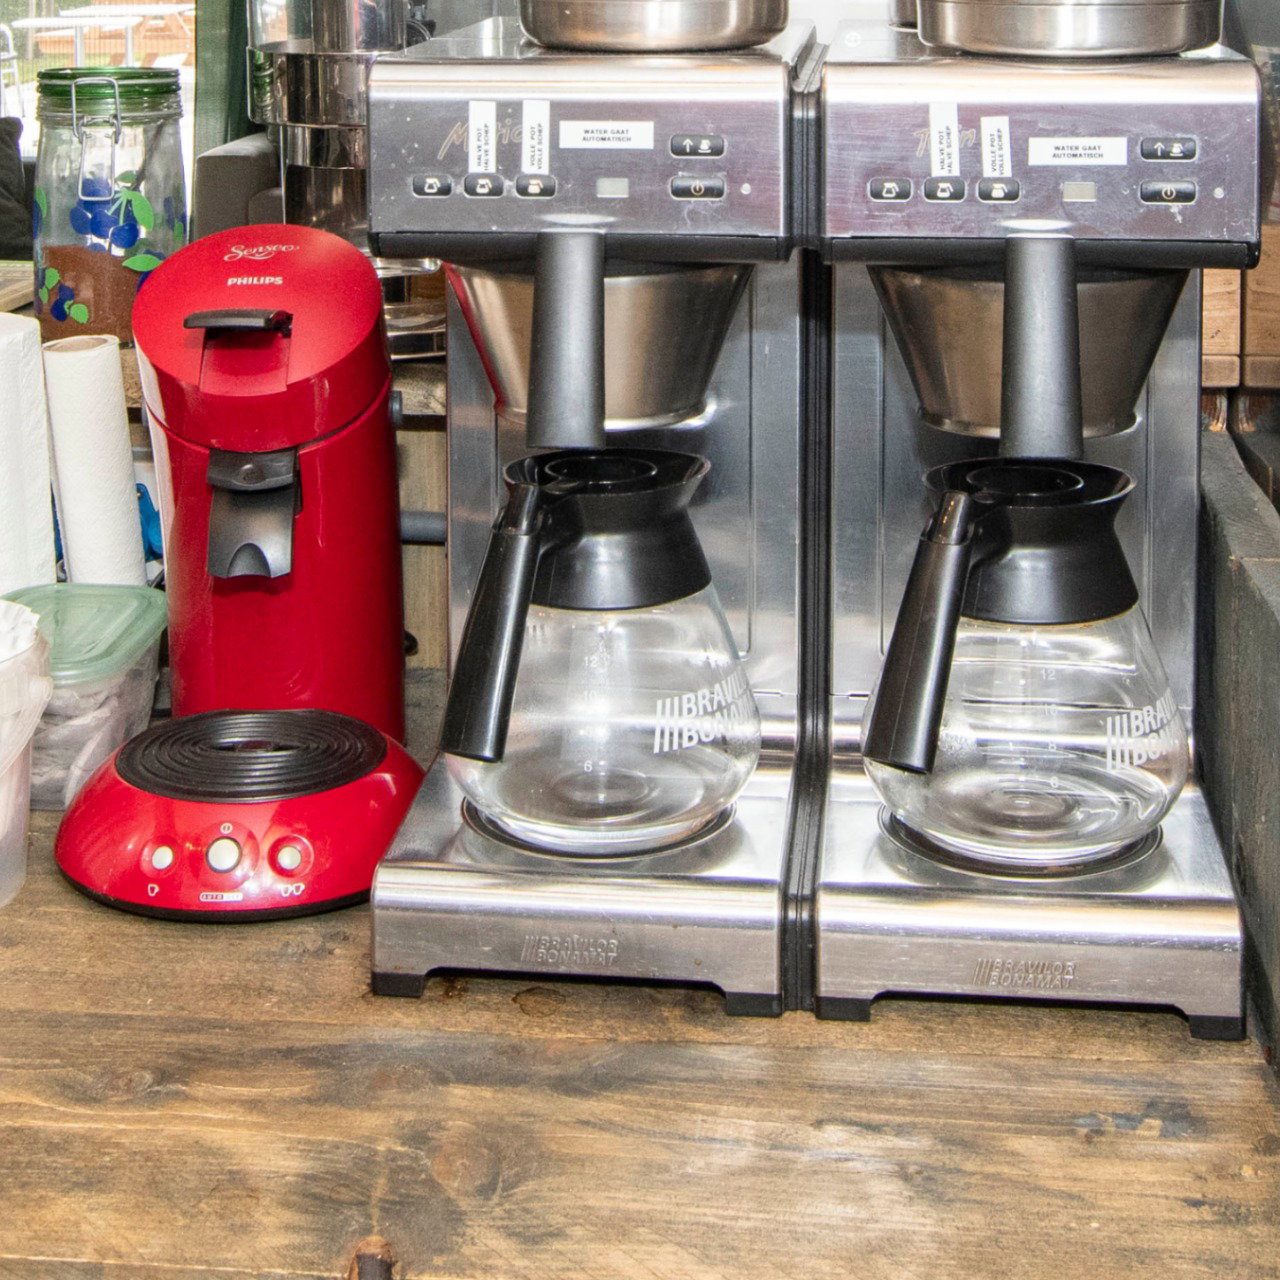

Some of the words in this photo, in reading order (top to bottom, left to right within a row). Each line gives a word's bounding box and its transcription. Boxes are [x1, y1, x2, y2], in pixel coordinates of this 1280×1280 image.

[224, 244, 294, 262] Senseo
[227, 276, 283, 286] PHILIPS
[584, 656, 598, 667] 12
[1040, 669, 1056, 680] 12
[583, 760, 593, 772] 6
[993, 958, 1076, 976] BRAVILOR
[989, 971, 1074, 988] BONAMAT
